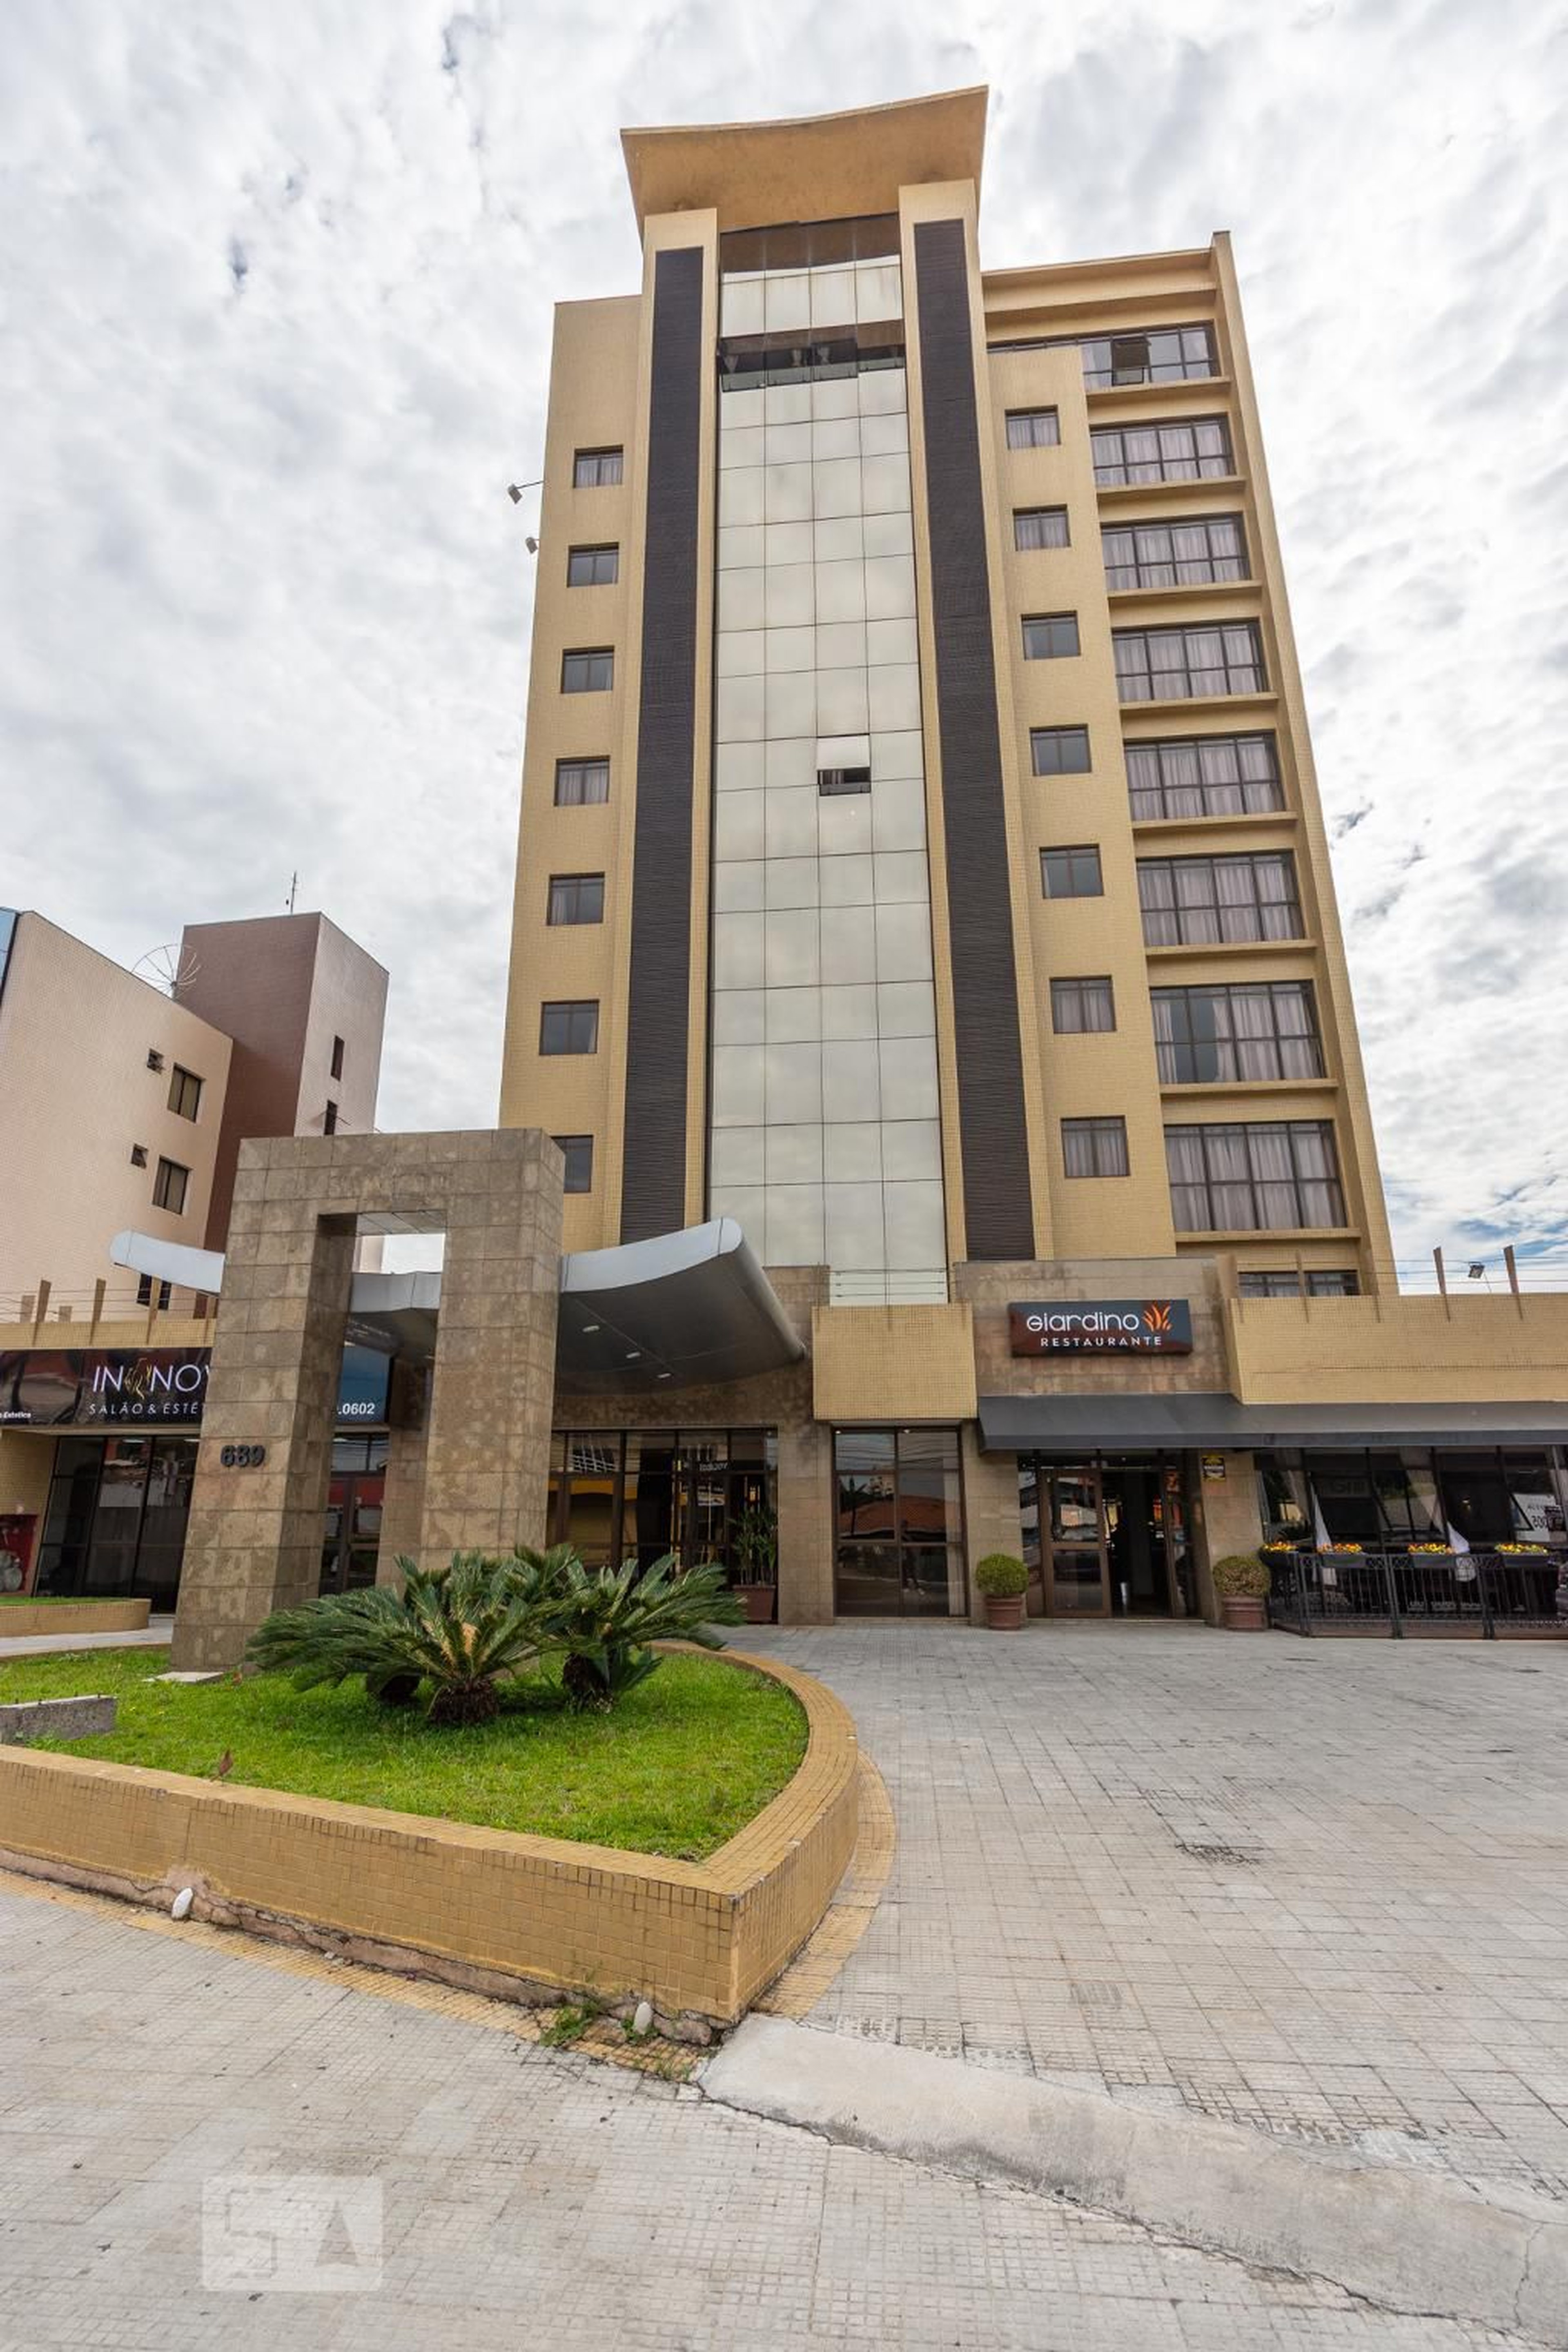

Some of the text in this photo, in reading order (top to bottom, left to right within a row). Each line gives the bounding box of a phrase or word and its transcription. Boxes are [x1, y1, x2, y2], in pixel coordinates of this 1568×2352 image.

[1040, 1336, 1162, 1347] RESTAURANTE
[89, 1401, 198, 1414] SALÃO & ESTÉ
[337, 1402, 375, 1415] .0602
[220, 1445, 265, 1468] 689
